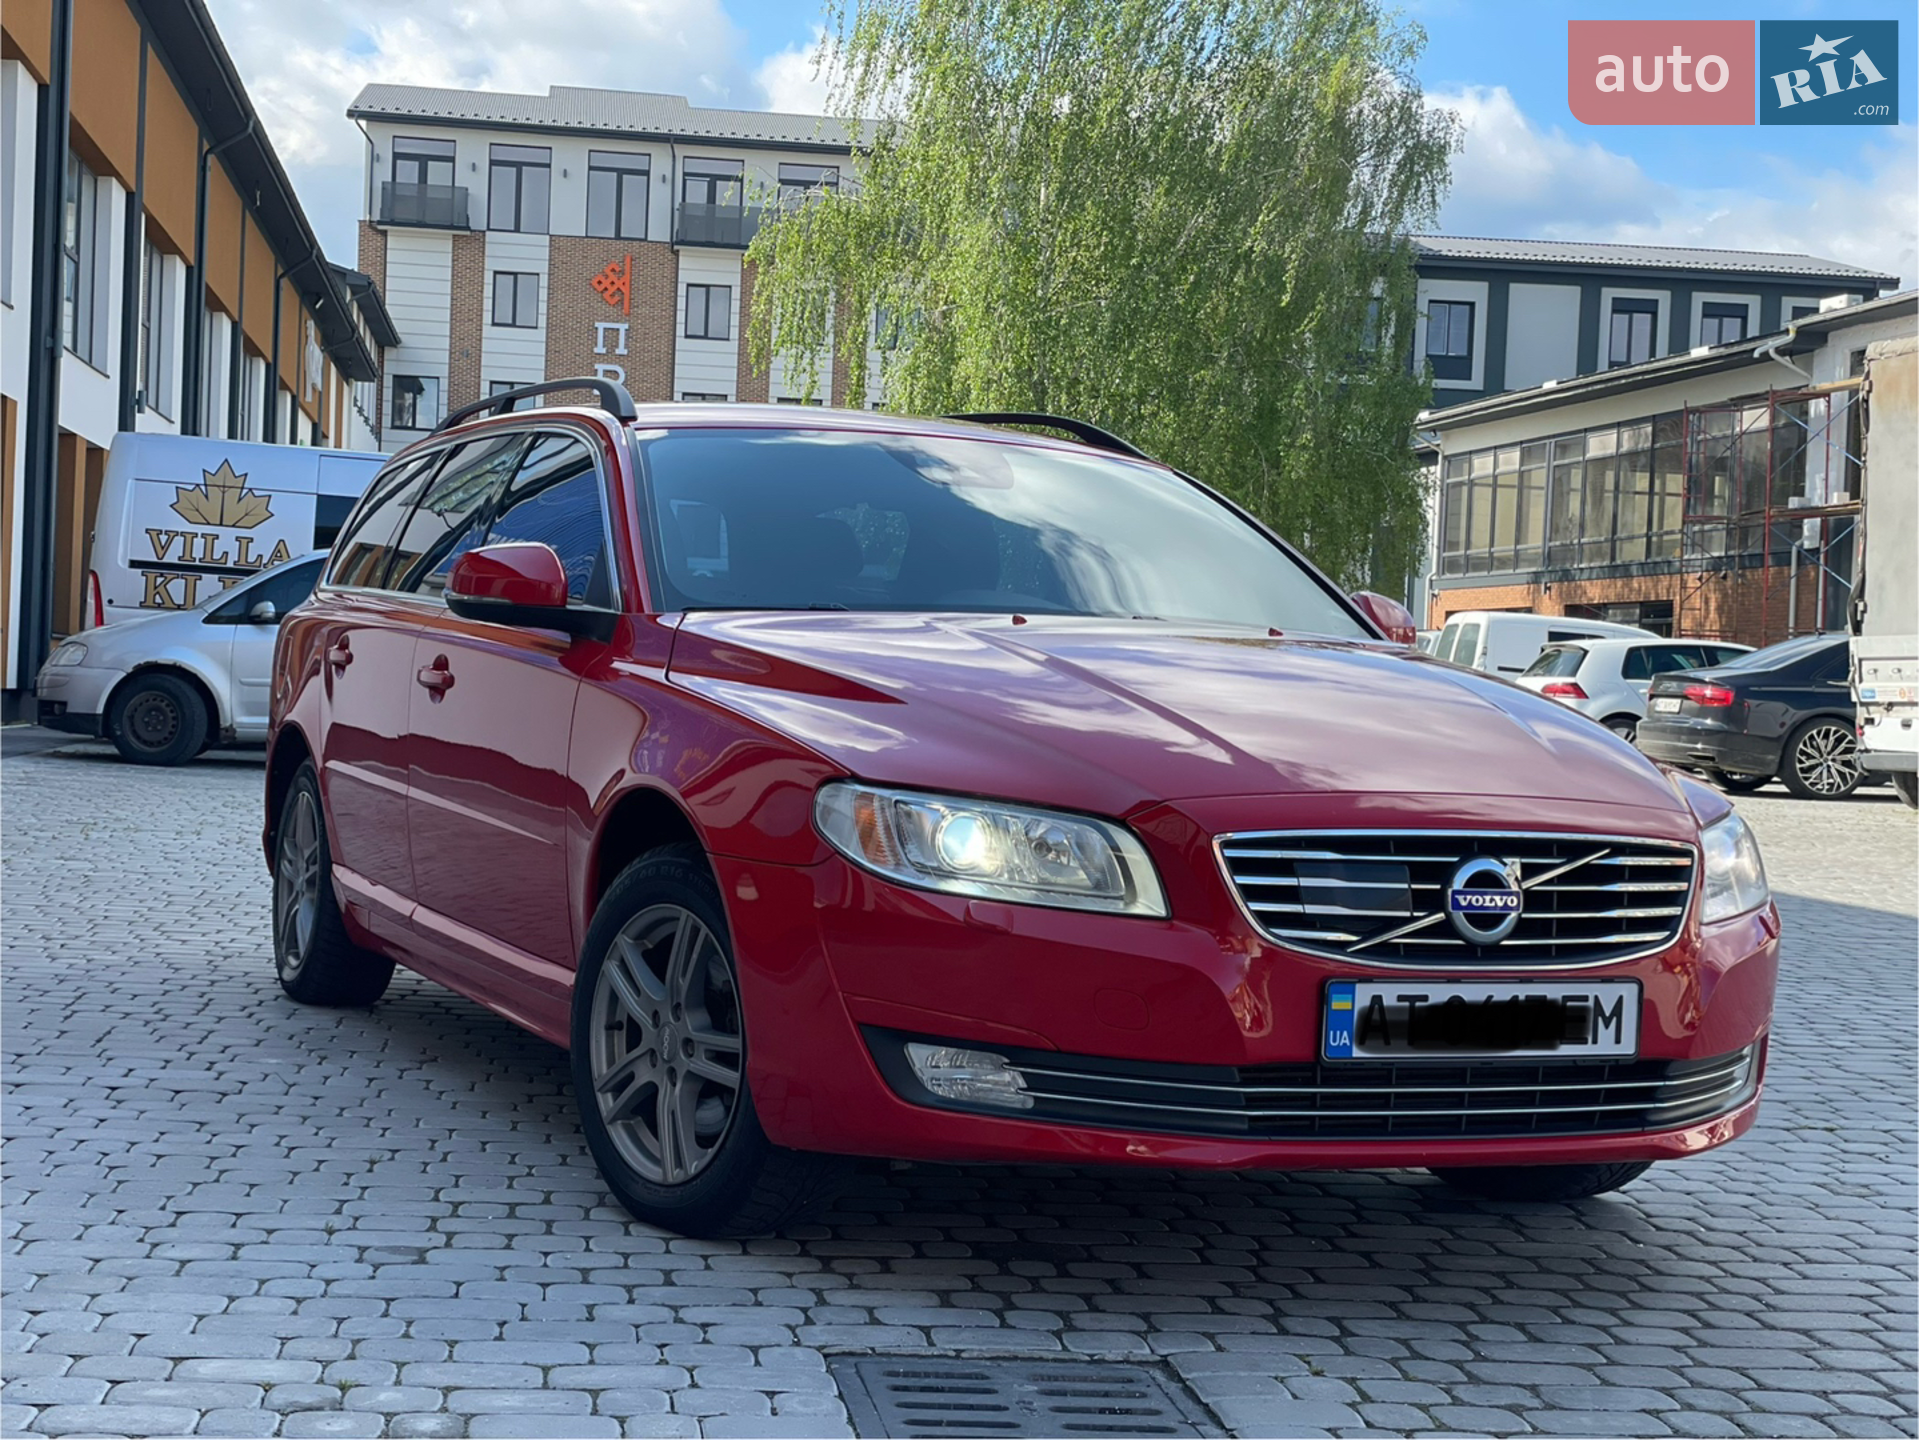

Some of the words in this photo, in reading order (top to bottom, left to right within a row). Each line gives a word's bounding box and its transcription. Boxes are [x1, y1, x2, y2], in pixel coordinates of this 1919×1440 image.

[145, 528, 292, 569] VILLA
[1455, 895, 1518, 907] VOLVO
[1329, 1030, 1351, 1047] UA
